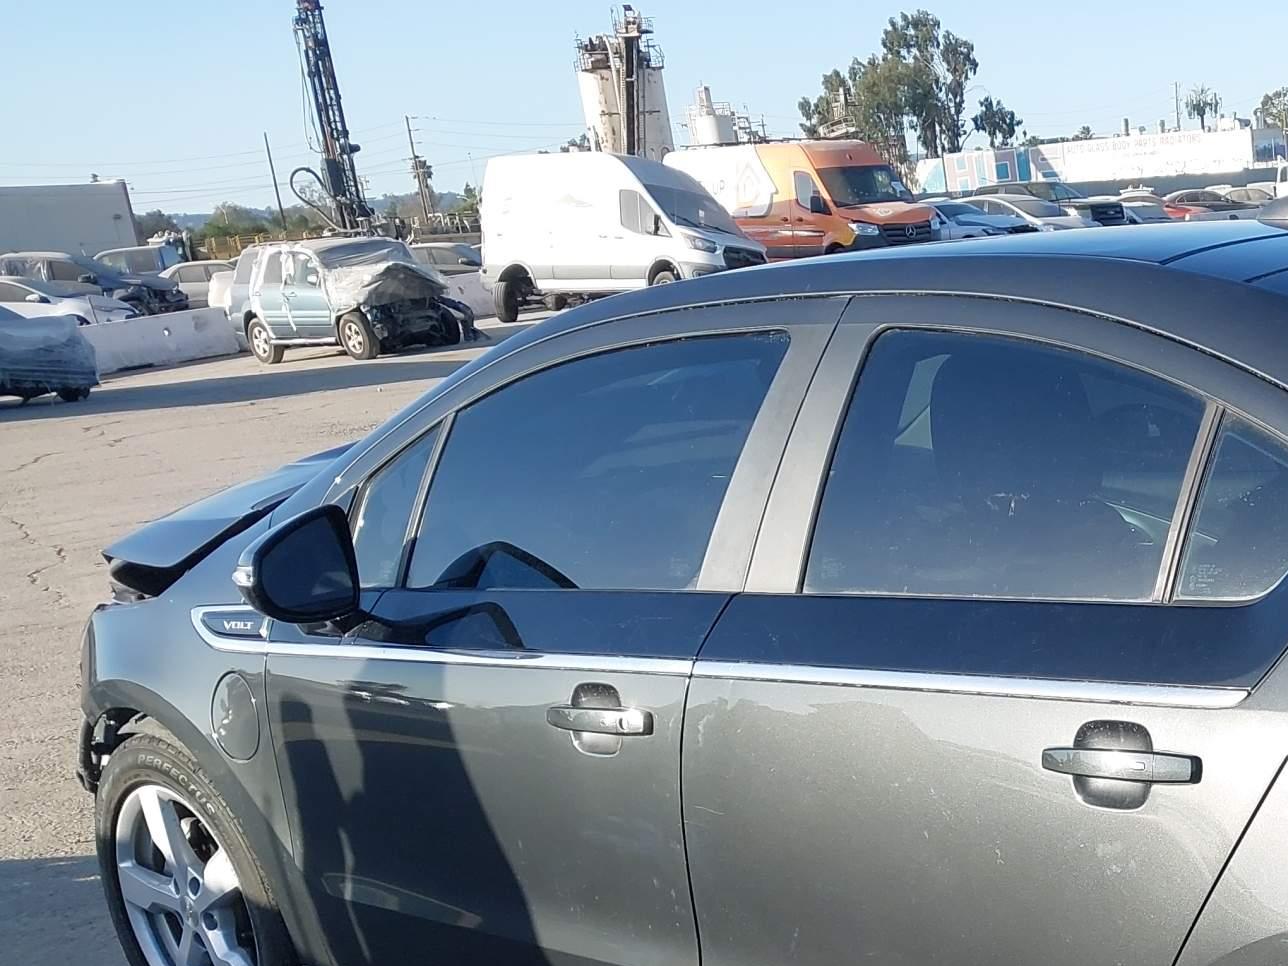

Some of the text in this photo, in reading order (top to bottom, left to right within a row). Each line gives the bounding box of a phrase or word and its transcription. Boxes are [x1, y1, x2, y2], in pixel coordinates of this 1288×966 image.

[1087, 141, 1109, 152] GLASS
[1111, 139, 1131, 151] BODY
[1134, 136, 1156, 147] PARTS
[1159, 134, 1201, 145] RADIATORS
[223, 620, 254, 631] VOLT
[137, 753, 216, 816] PERFECTUS
